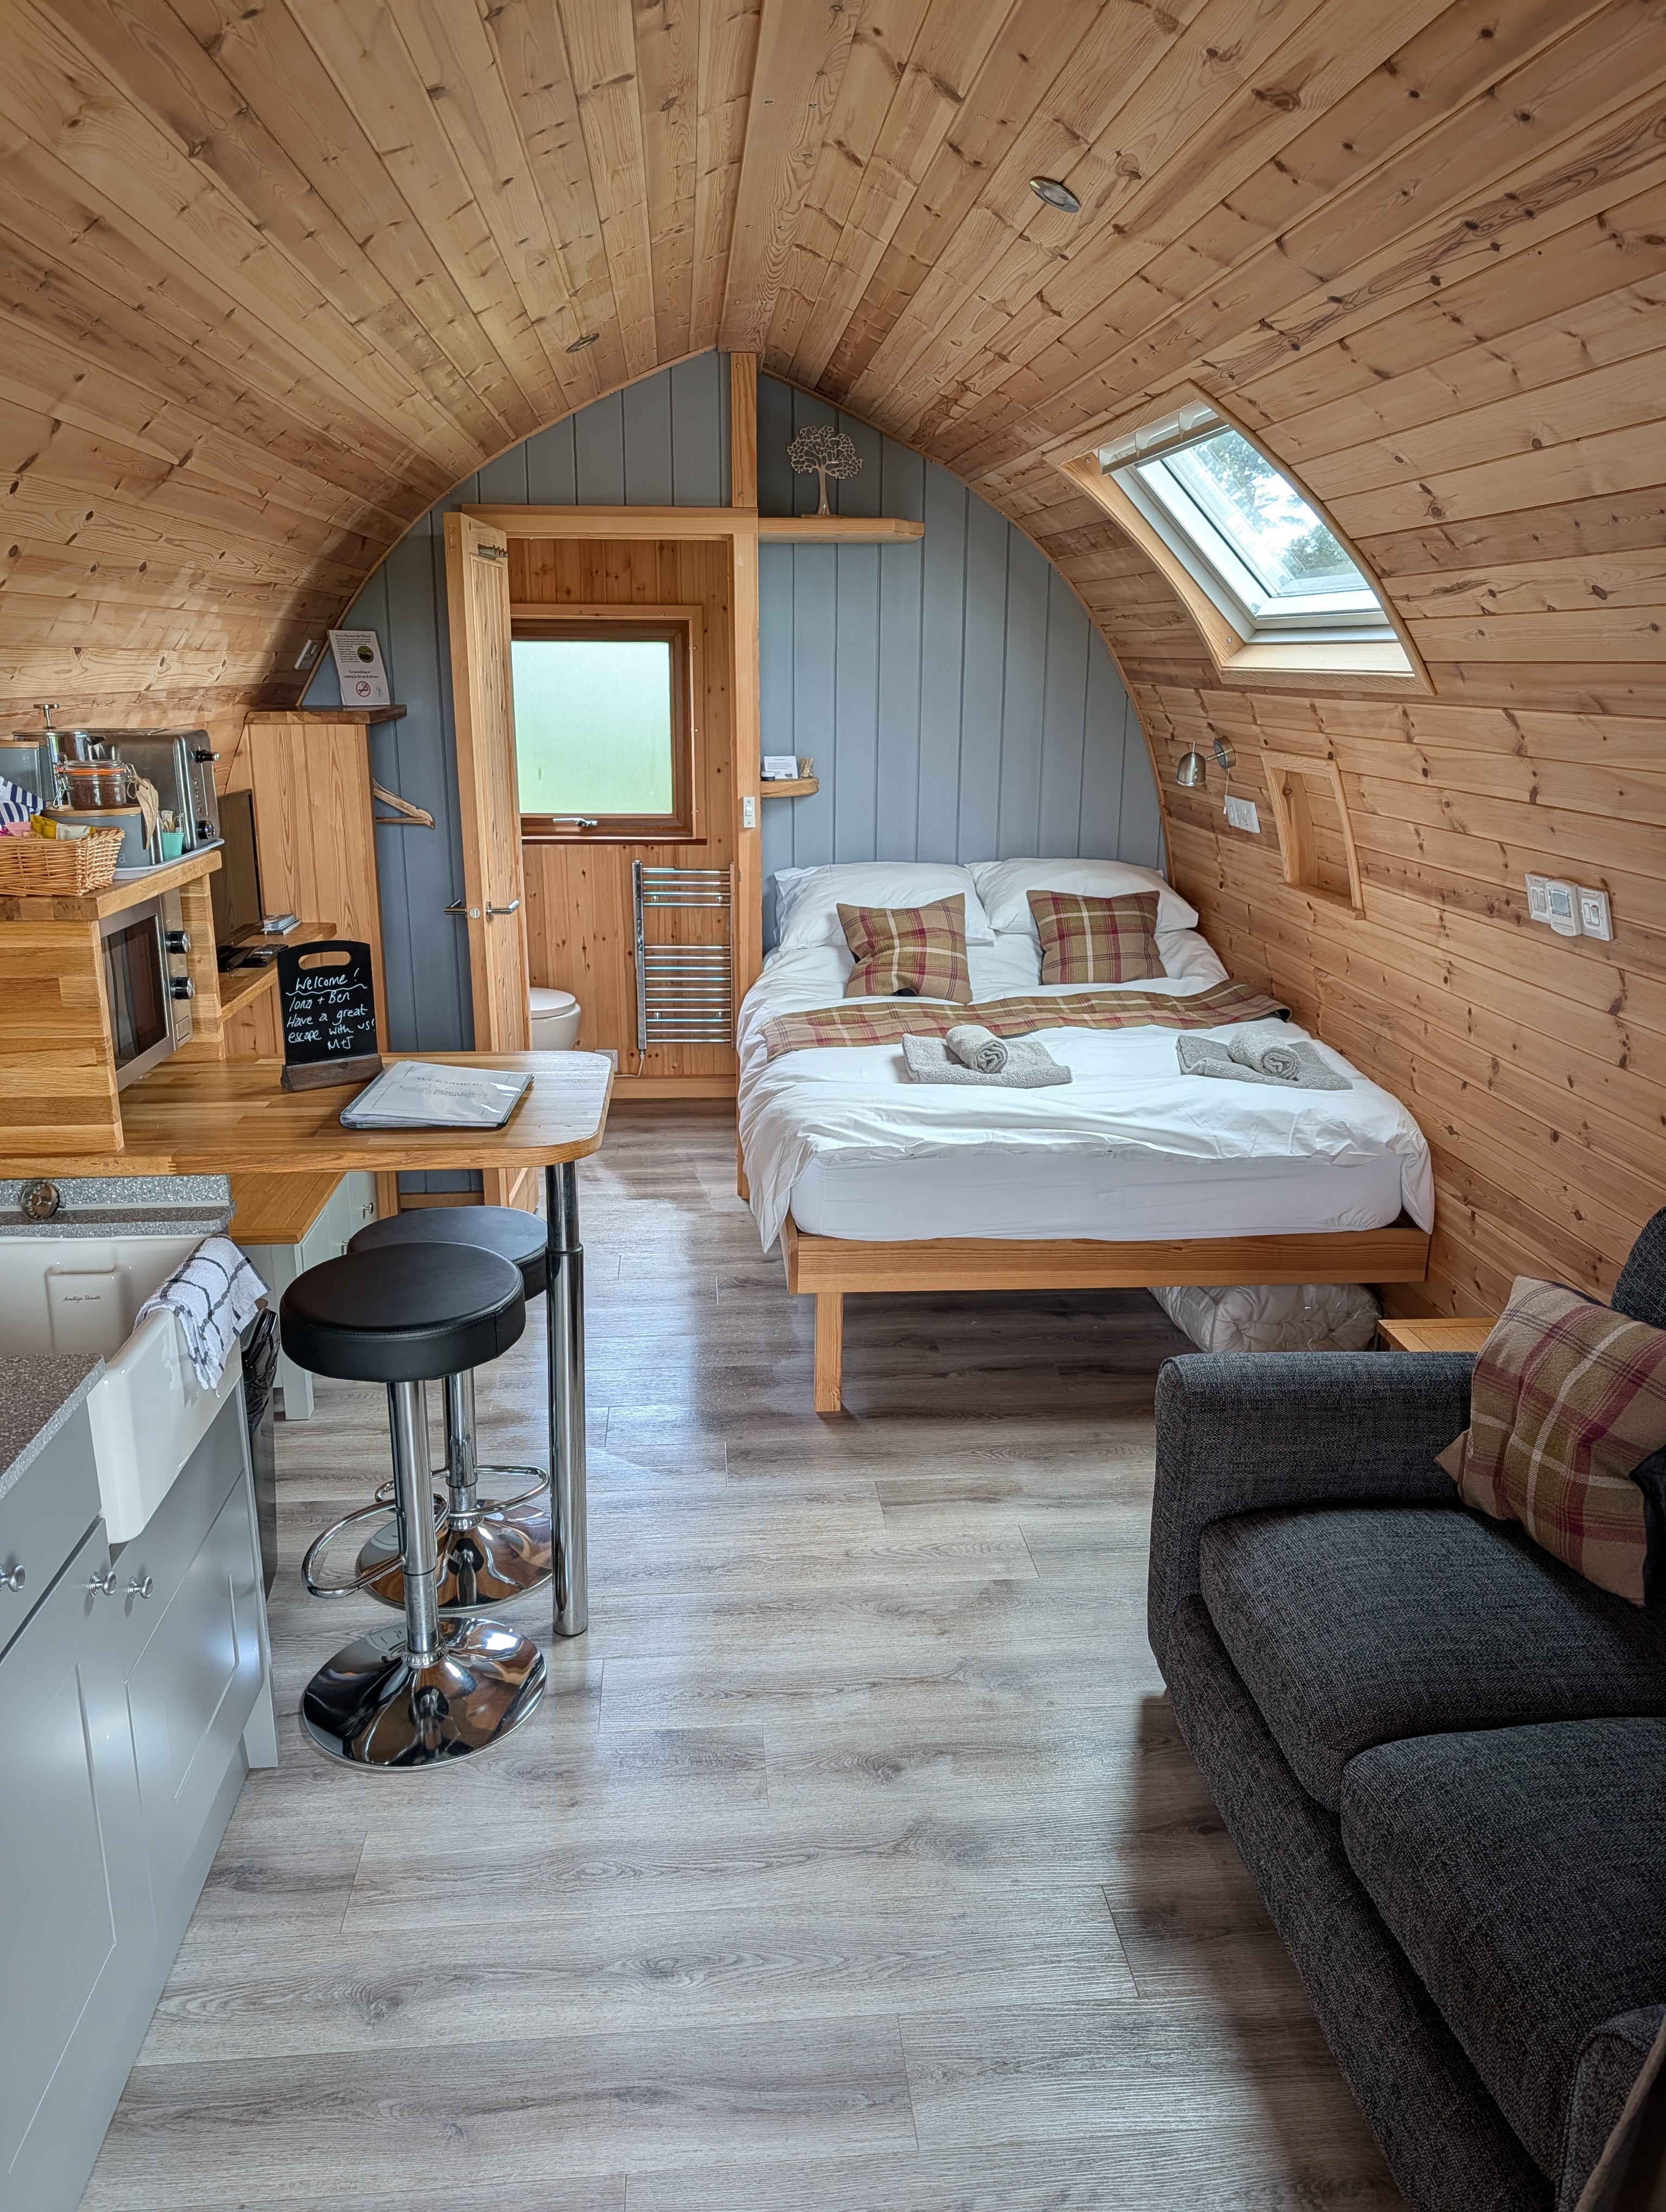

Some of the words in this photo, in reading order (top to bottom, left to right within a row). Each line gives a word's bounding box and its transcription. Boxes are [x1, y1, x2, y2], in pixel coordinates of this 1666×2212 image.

[328, 991, 350, 1003] Ben
[286, 1013, 313, 1028] Have
[319, 1013, 328, 1021] a
[332, 1004, 368, 1026] great
[288, 1030, 322, 1043] escape
[329, 1024, 354, 1035] with
